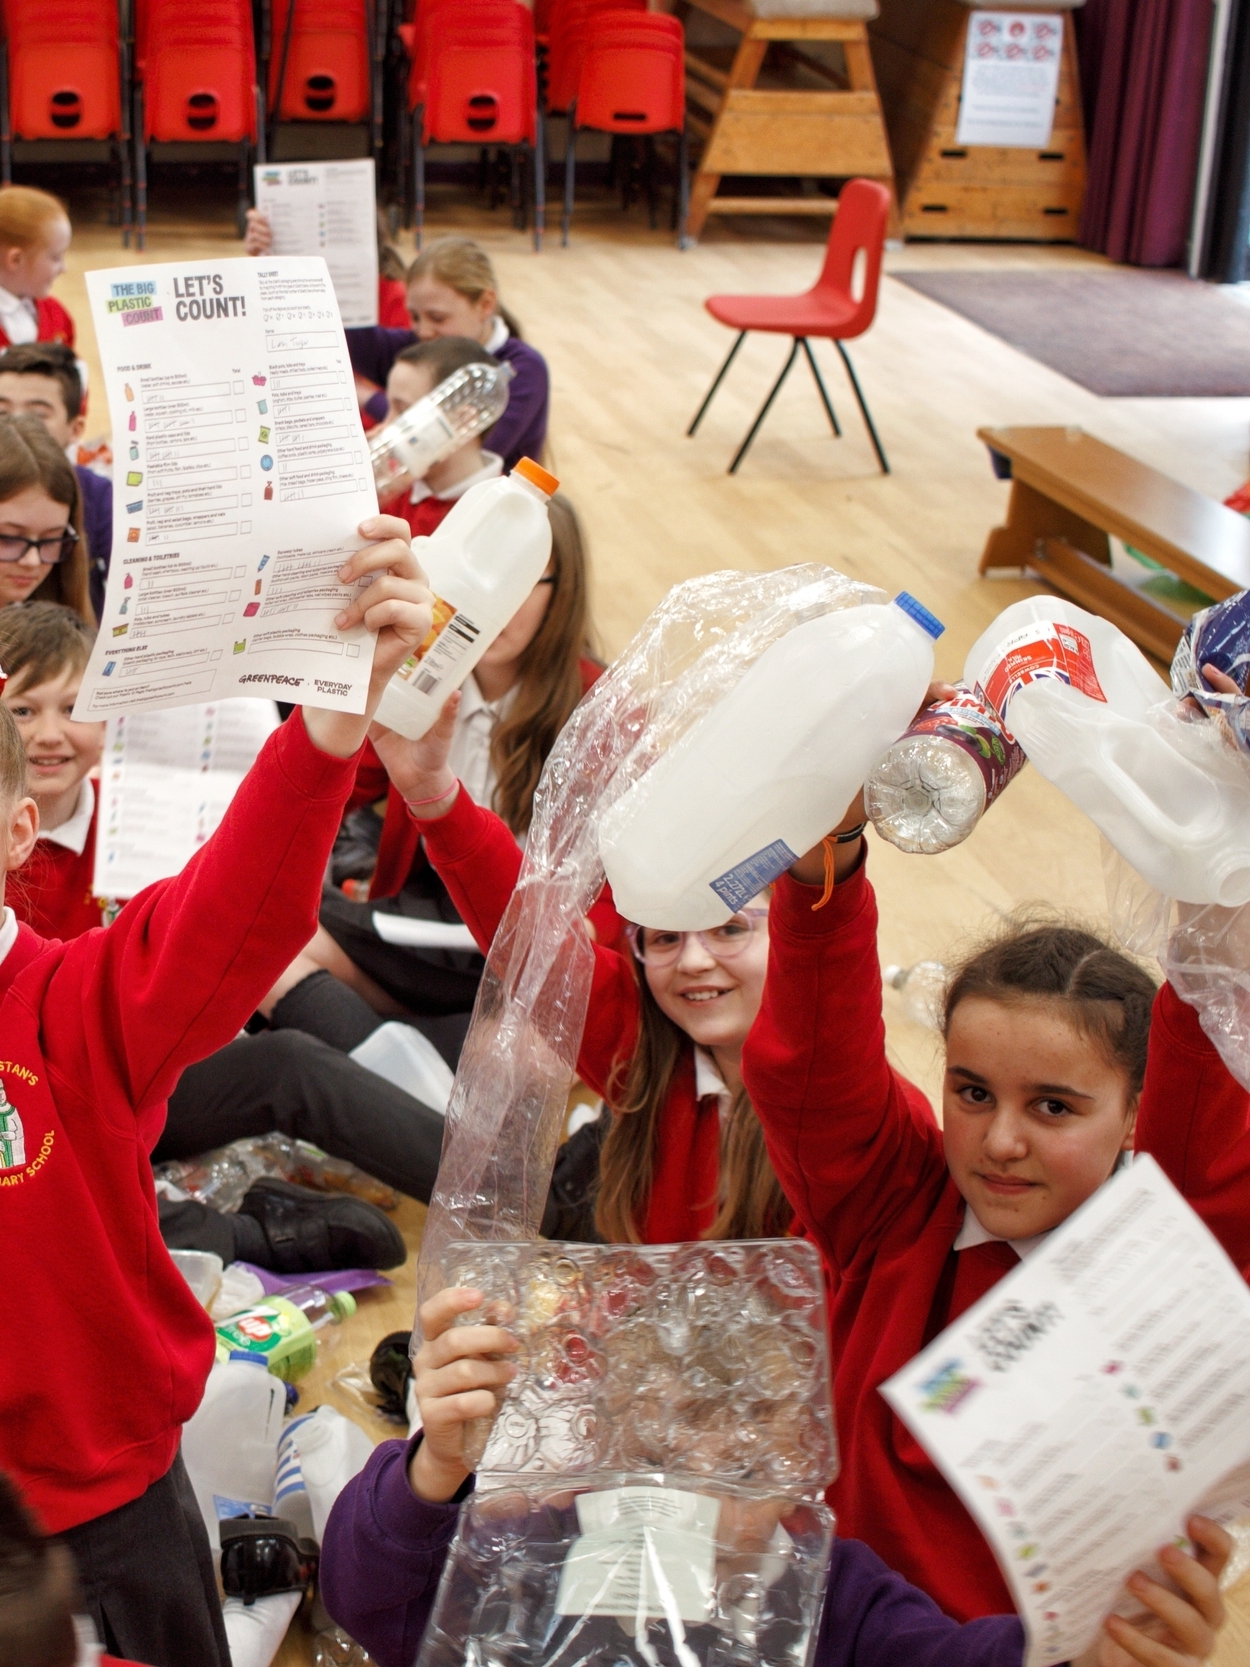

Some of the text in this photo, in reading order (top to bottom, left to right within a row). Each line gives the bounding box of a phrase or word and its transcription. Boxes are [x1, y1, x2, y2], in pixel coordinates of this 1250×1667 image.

[113, 282, 154, 297] THE BIG
[173, 274, 224, 298] LET'S
[108, 297, 152, 312] PLASTIC
[176, 296, 246, 322] COUNT!
[125, 309, 159, 324] COUNT
[123, 556, 148, 565] CLEANING
[153, 552, 180, 561] TOILETRIES
[105, 646, 135, 656] EVERYTHING
[1004, 655, 1032, 673] SKIMMED
[239, 674, 304, 687] GREENPEACE
[1008, 664, 1040, 684] COWBELLE
[314, 679, 353, 691] EVERYDAY
[316, 686, 349, 697] PLASTIC
[717, 885, 739, 905] pints
[26, 1130, 55, 1177] SCHOOL
